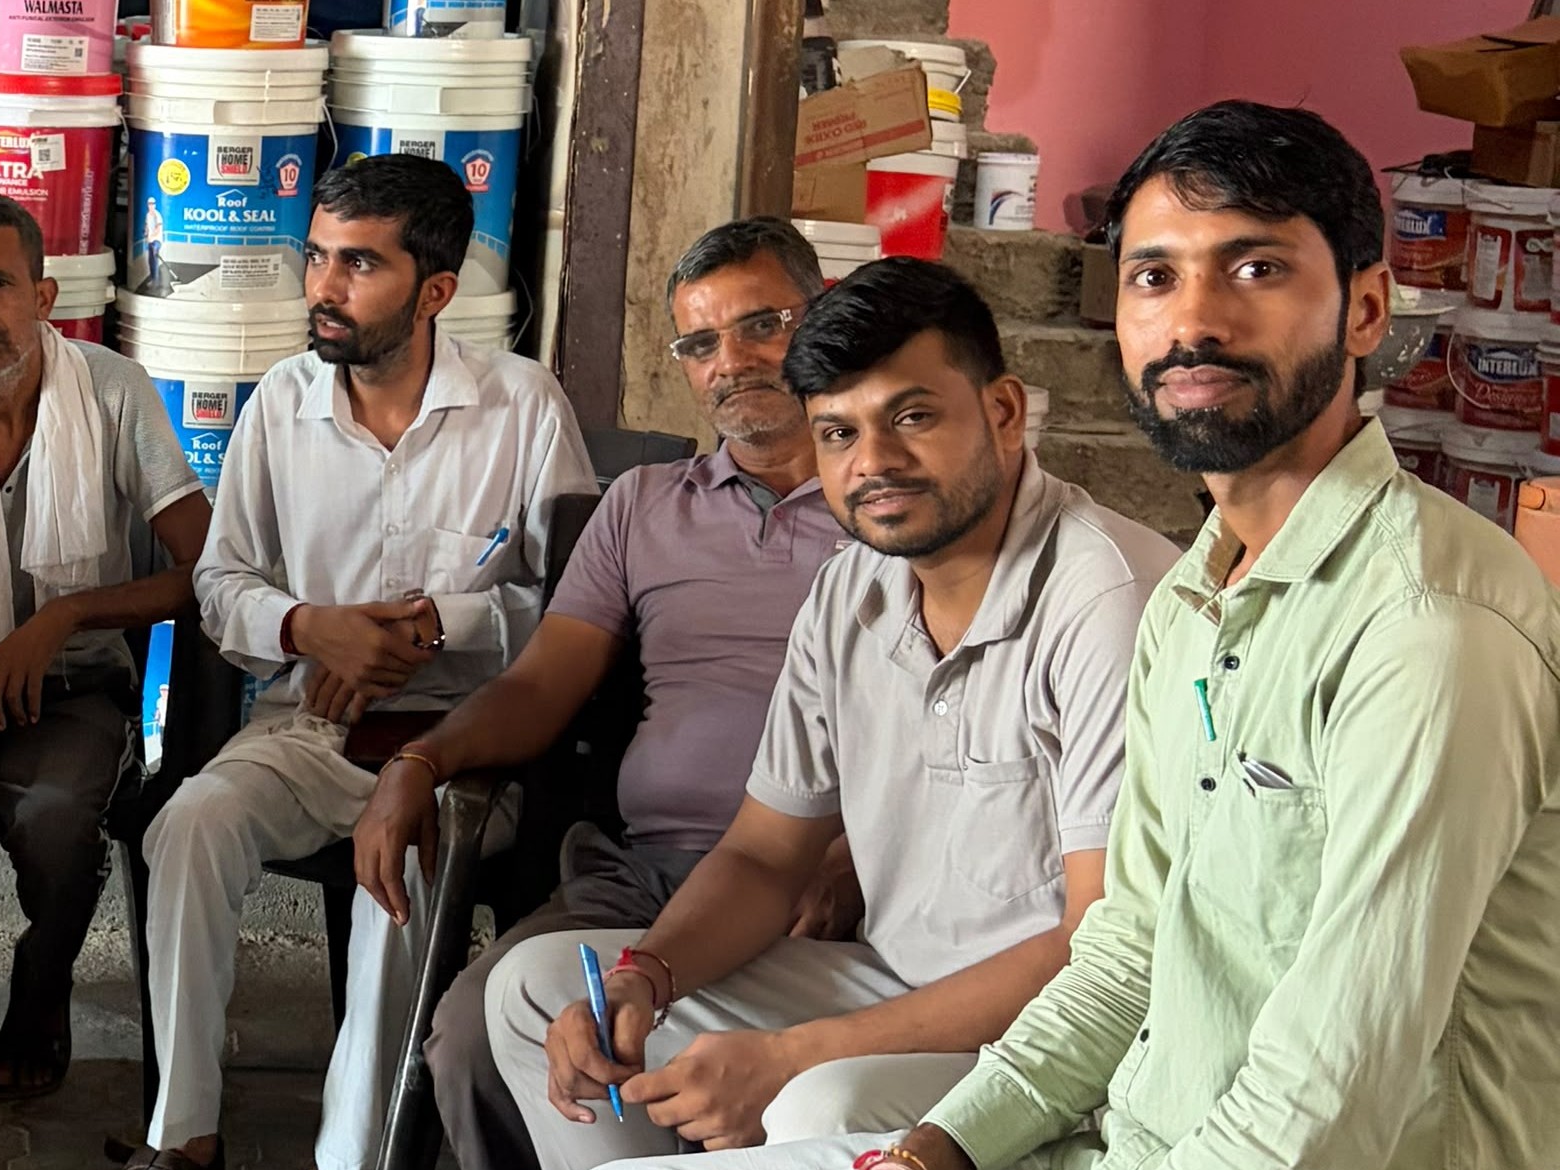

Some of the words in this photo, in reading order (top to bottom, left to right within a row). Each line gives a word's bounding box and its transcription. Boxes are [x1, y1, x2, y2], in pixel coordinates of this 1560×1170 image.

[24, 0, 83, 14] WALMASTA
[400, 140, 435, 148] BERGER
[221, 154, 248, 165] HOME
[284, 168, 297, 182] 10
[471, 163, 487, 177] 10
[217, 197, 247, 207] Roof
[184, 208, 226, 222] KOOL
[228, 209, 241, 222] &
[243, 210, 276, 222] SEAL
[1478, 358, 1538, 377] INTERLUX
[197, 400, 222, 410] HOME
[193, 440, 223, 450] Roof
[203, 453, 216, 464] &
